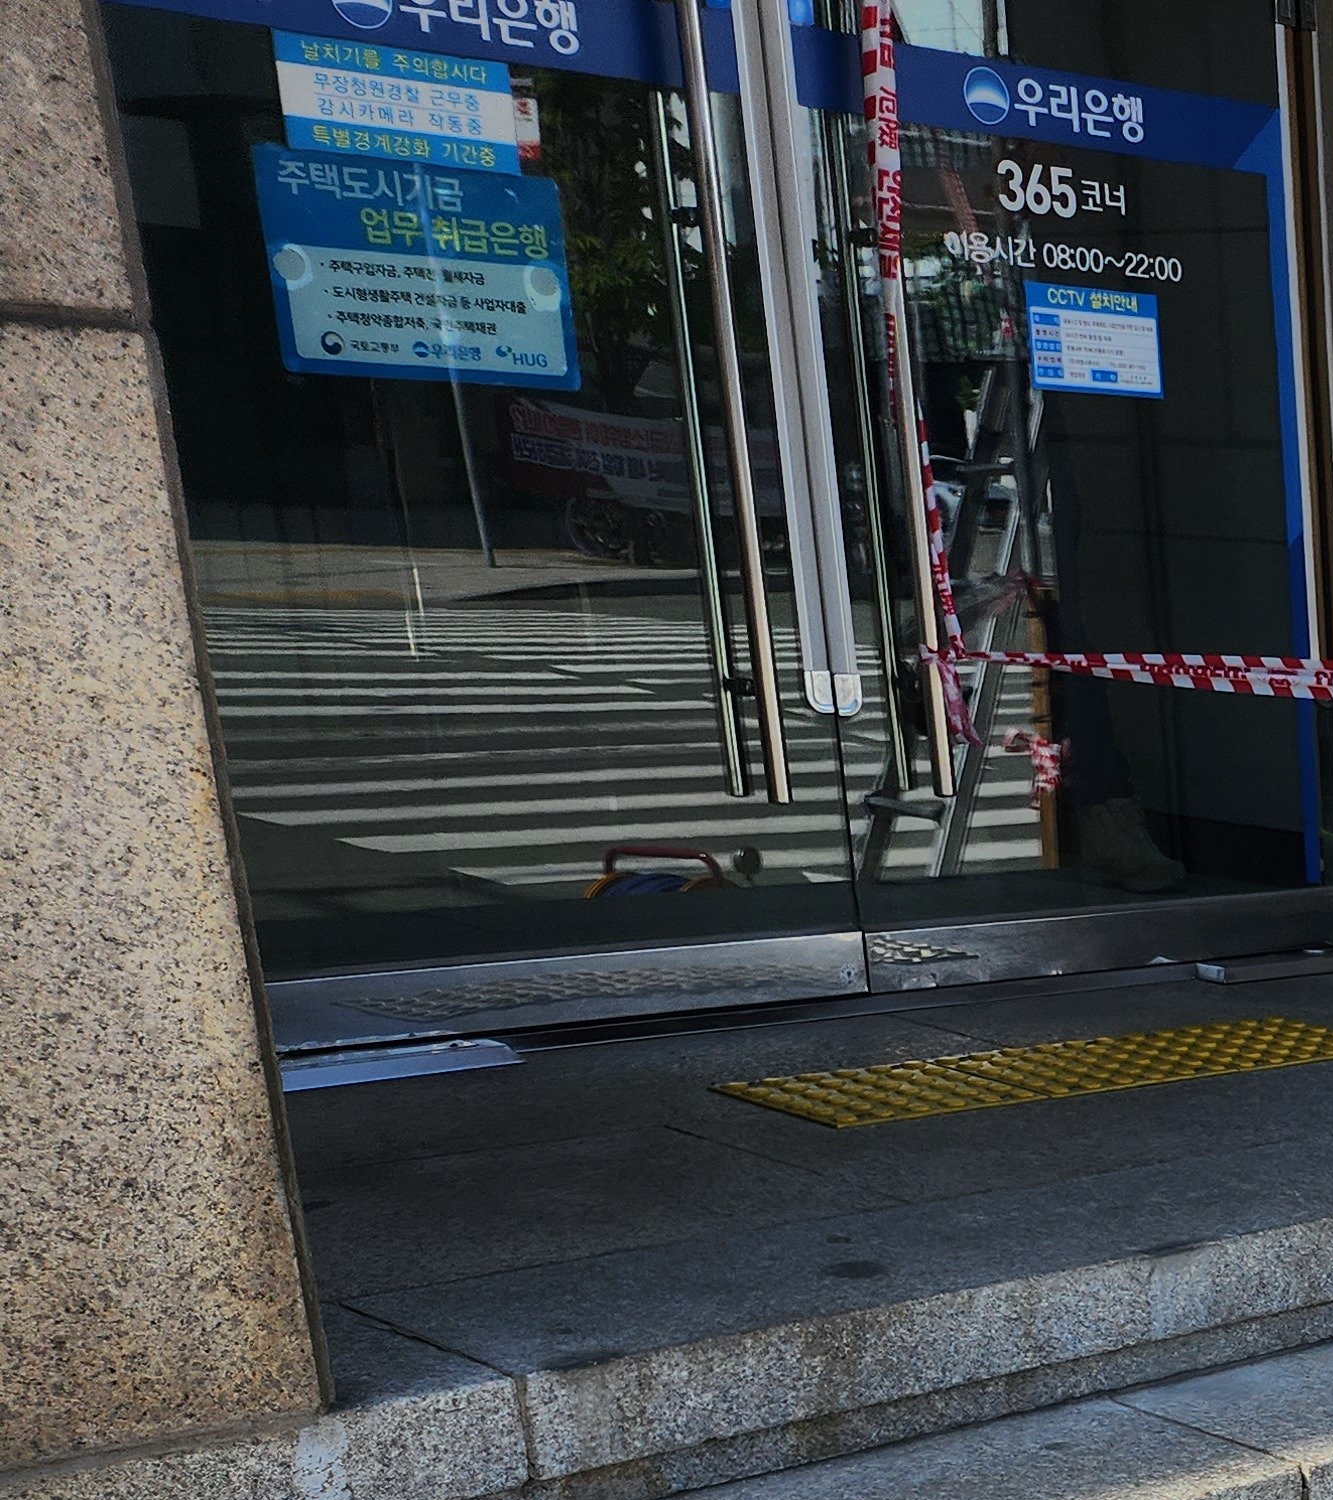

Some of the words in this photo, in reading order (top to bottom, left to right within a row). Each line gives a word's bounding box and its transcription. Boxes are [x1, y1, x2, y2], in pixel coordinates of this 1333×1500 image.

[398, 0, 580, 55] 우리은행
[300, 40, 382, 70] 날치기를
[392, 53, 487, 83] 주의합시다
[313, 72, 420, 102] 무장청원경찰
[430, 88, 482, 112] 근무중
[1014, 78, 1144, 143] 우리은행
[317, 98, 415, 126] 감시카메라
[428, 114, 483, 136] 작동중
[311, 124, 431, 158] 특별경계강화
[441, 142, 496, 167] 기간중
[277, 158, 464, 213] 주택도시기금
[997, 159, 1077, 219] 365
[1081, 178, 1126, 216] 코너
[360, 206, 423, 247] 업무
[431, 213, 550, 260] 취급은행
[943, 231, 1037, 268] 이용시간
[1042, 242, 1183, 282] 08:00~22:00
[474, 297, 527, 315] 사업자대출
[1047, 287, 1086, 307] CCTV
[1090, 291, 1138, 313] 설치안내
[512, 352, 548, 368] HUG
